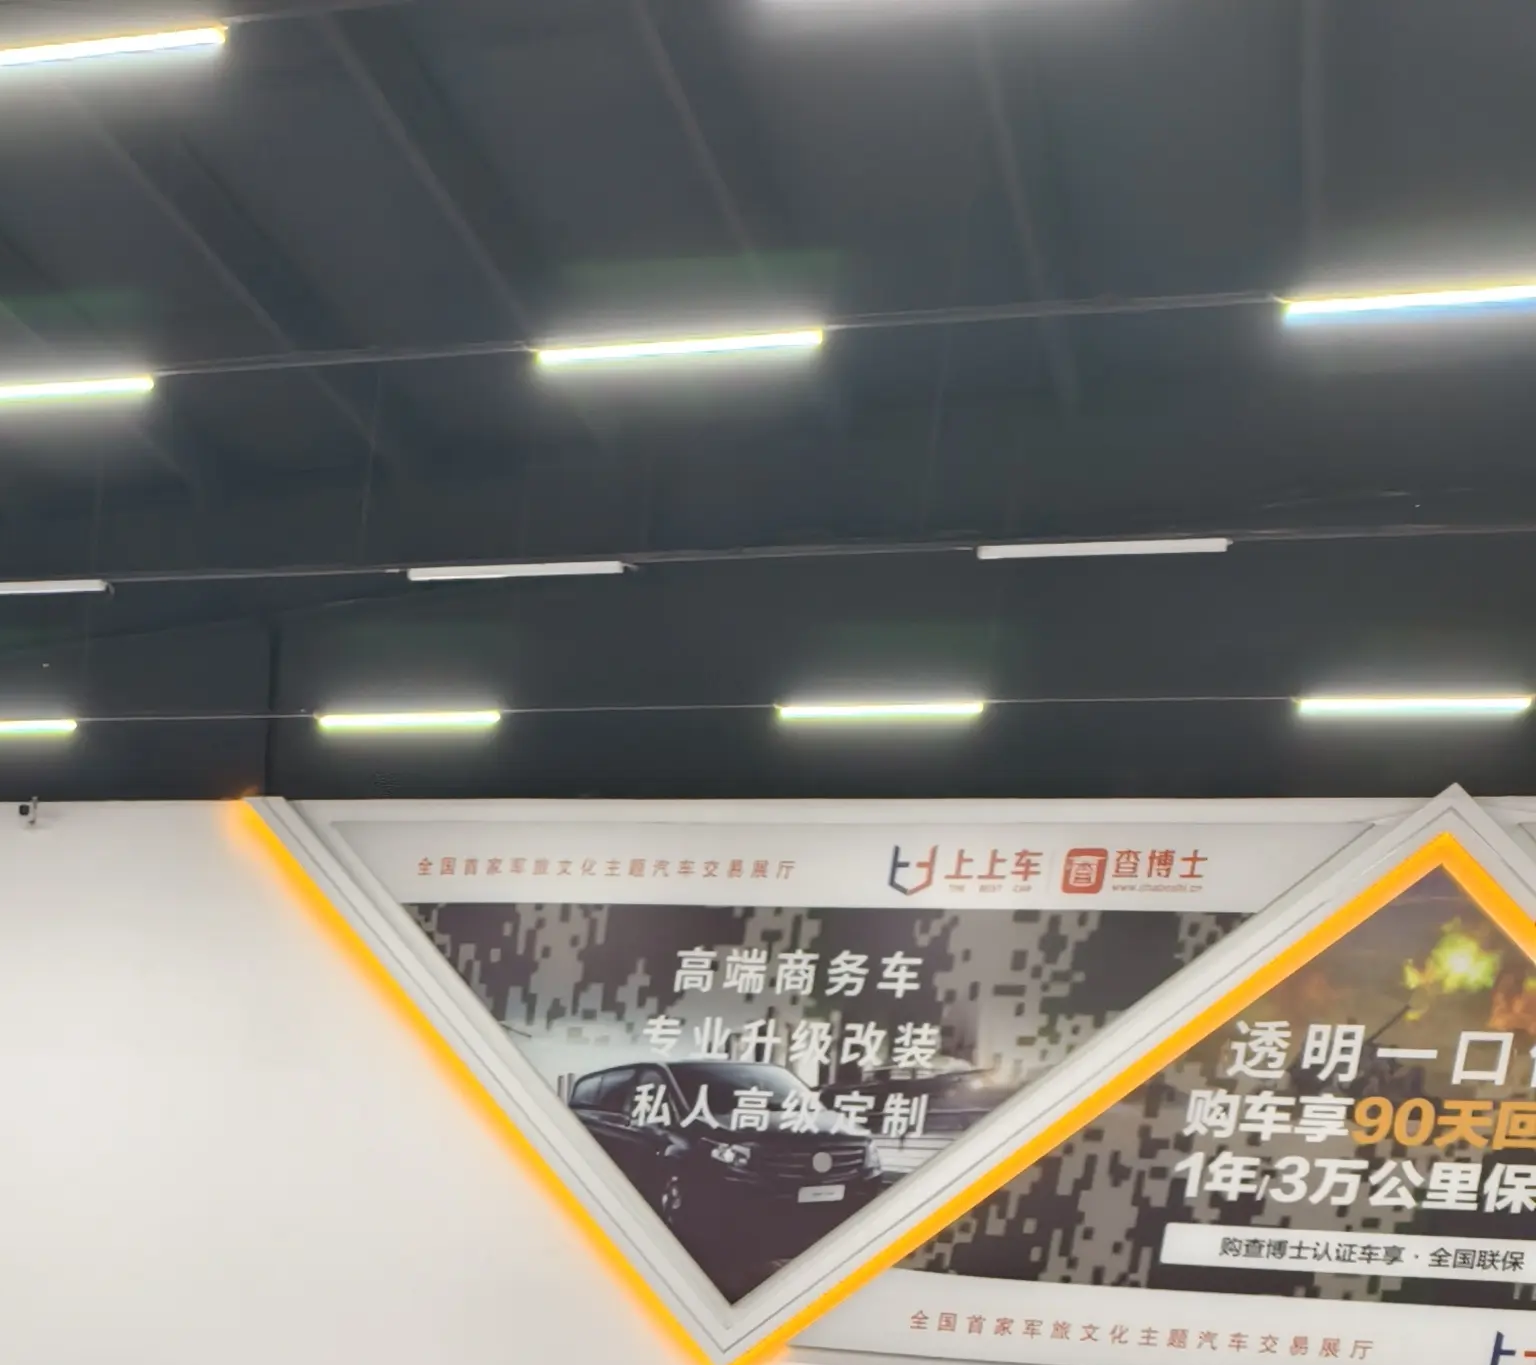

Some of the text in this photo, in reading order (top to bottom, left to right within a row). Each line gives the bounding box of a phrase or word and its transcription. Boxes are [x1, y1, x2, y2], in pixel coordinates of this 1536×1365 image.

[944, 848, 1043, 881] 上上车
[1111, 848, 1208, 879] 查博士
[672, 944, 924, 998] 高端商务车
[642, 1014, 941, 1070] 专业升级改装
[1226, 1019, 1536, 1088] 透明一口
[630, 1083, 931, 1140] 私人高级定制
[909, 1309, 1376, 1361] 全国首家军旅文化主题汽车交易展厅
